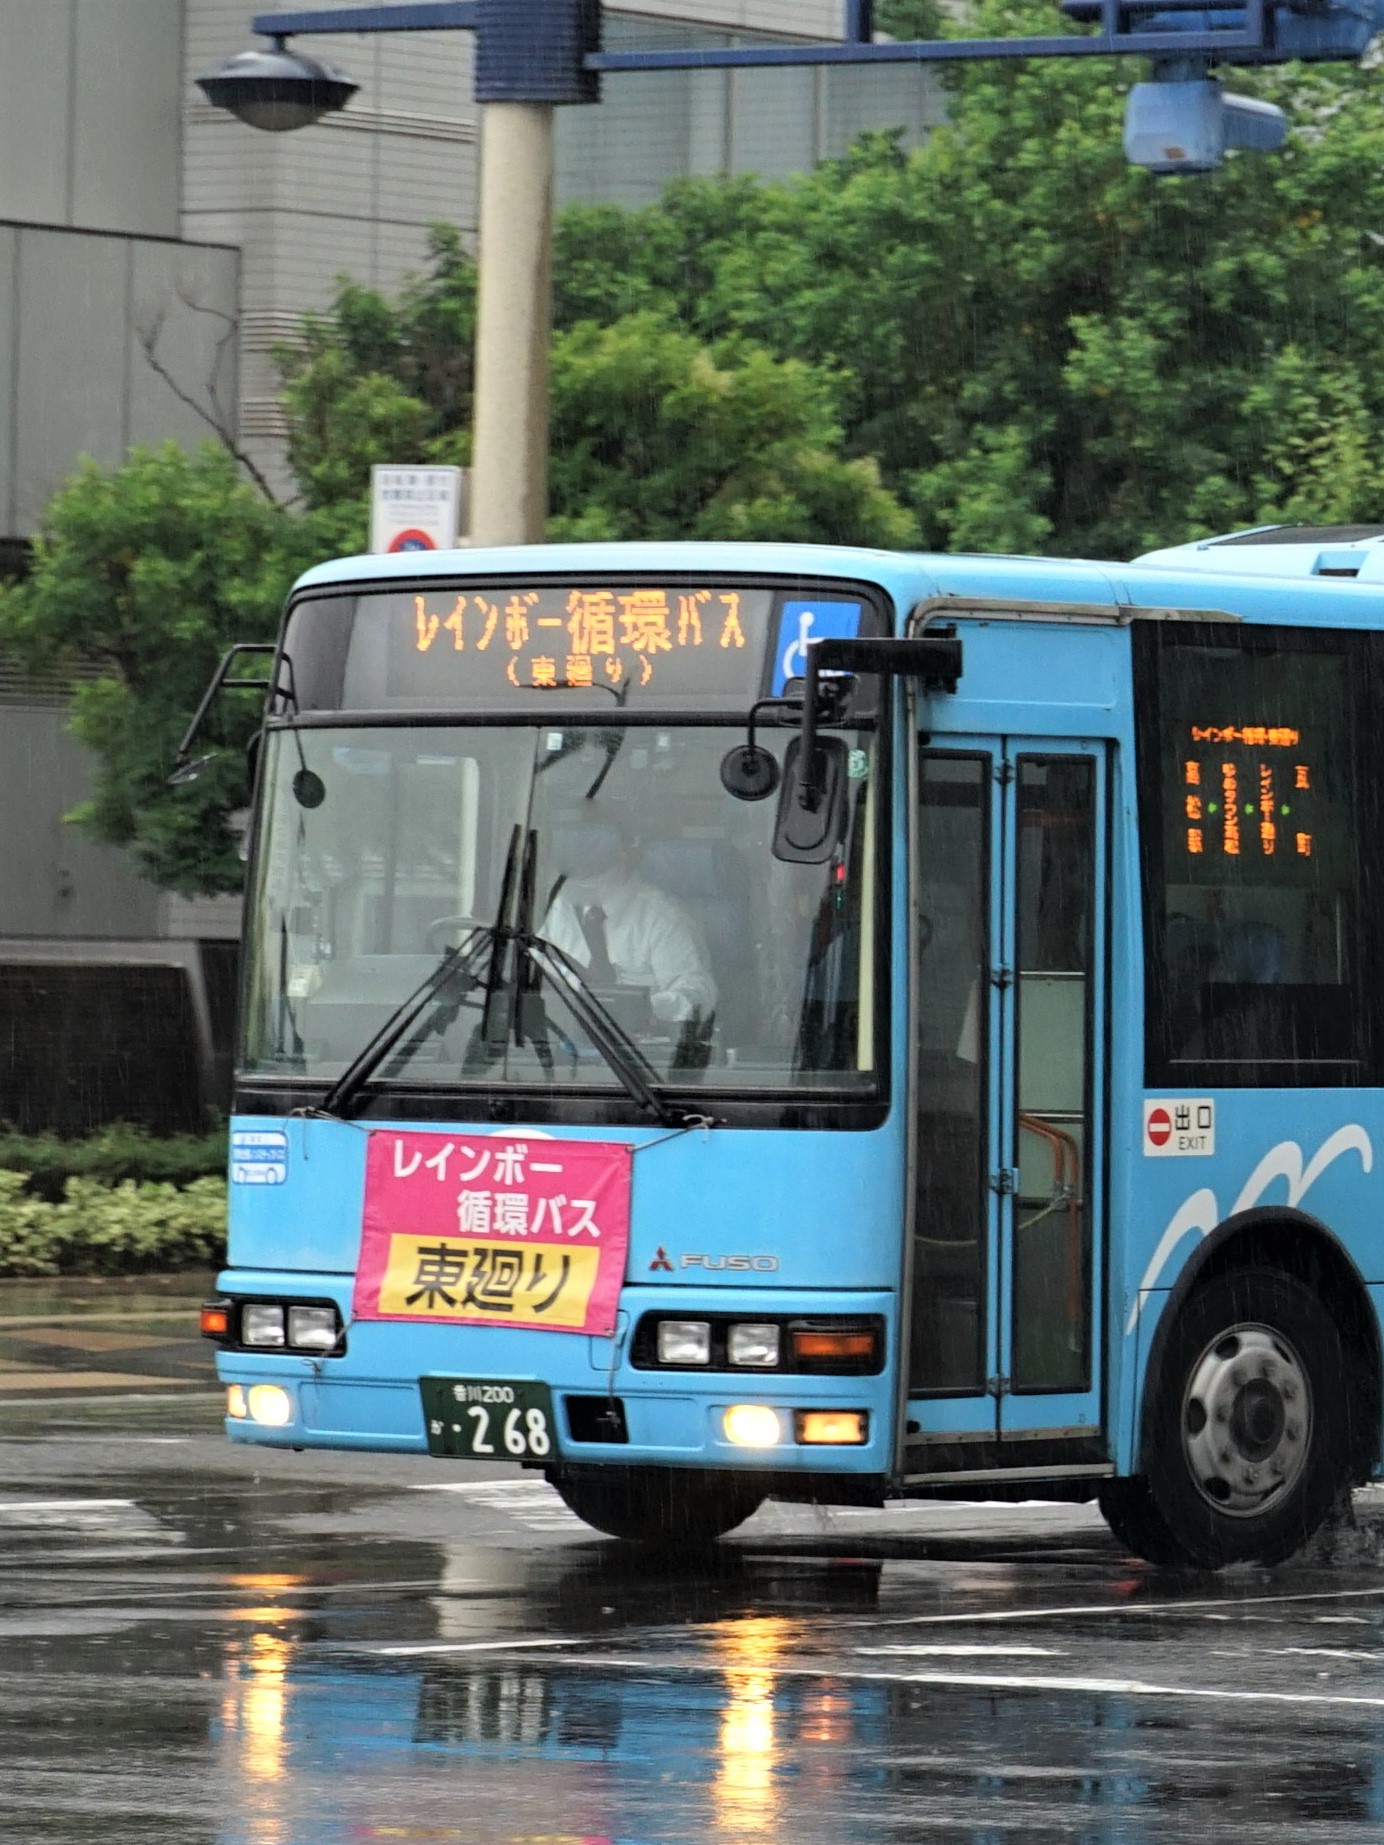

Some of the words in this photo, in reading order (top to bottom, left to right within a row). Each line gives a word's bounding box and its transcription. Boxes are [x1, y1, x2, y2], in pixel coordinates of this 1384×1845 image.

[414, 590, 746, 654] レインボー循環バス
[1175, 1104, 1212, 1130] 出口
[393, 1138, 563, 1186] レインボー
[1179, 1136, 1207, 1150] EXIT
[456, 1189, 601, 1239] 循環バス
[405, 1243, 571, 1313] 東廻り
[679, 1253, 779, 1273] FUSO
